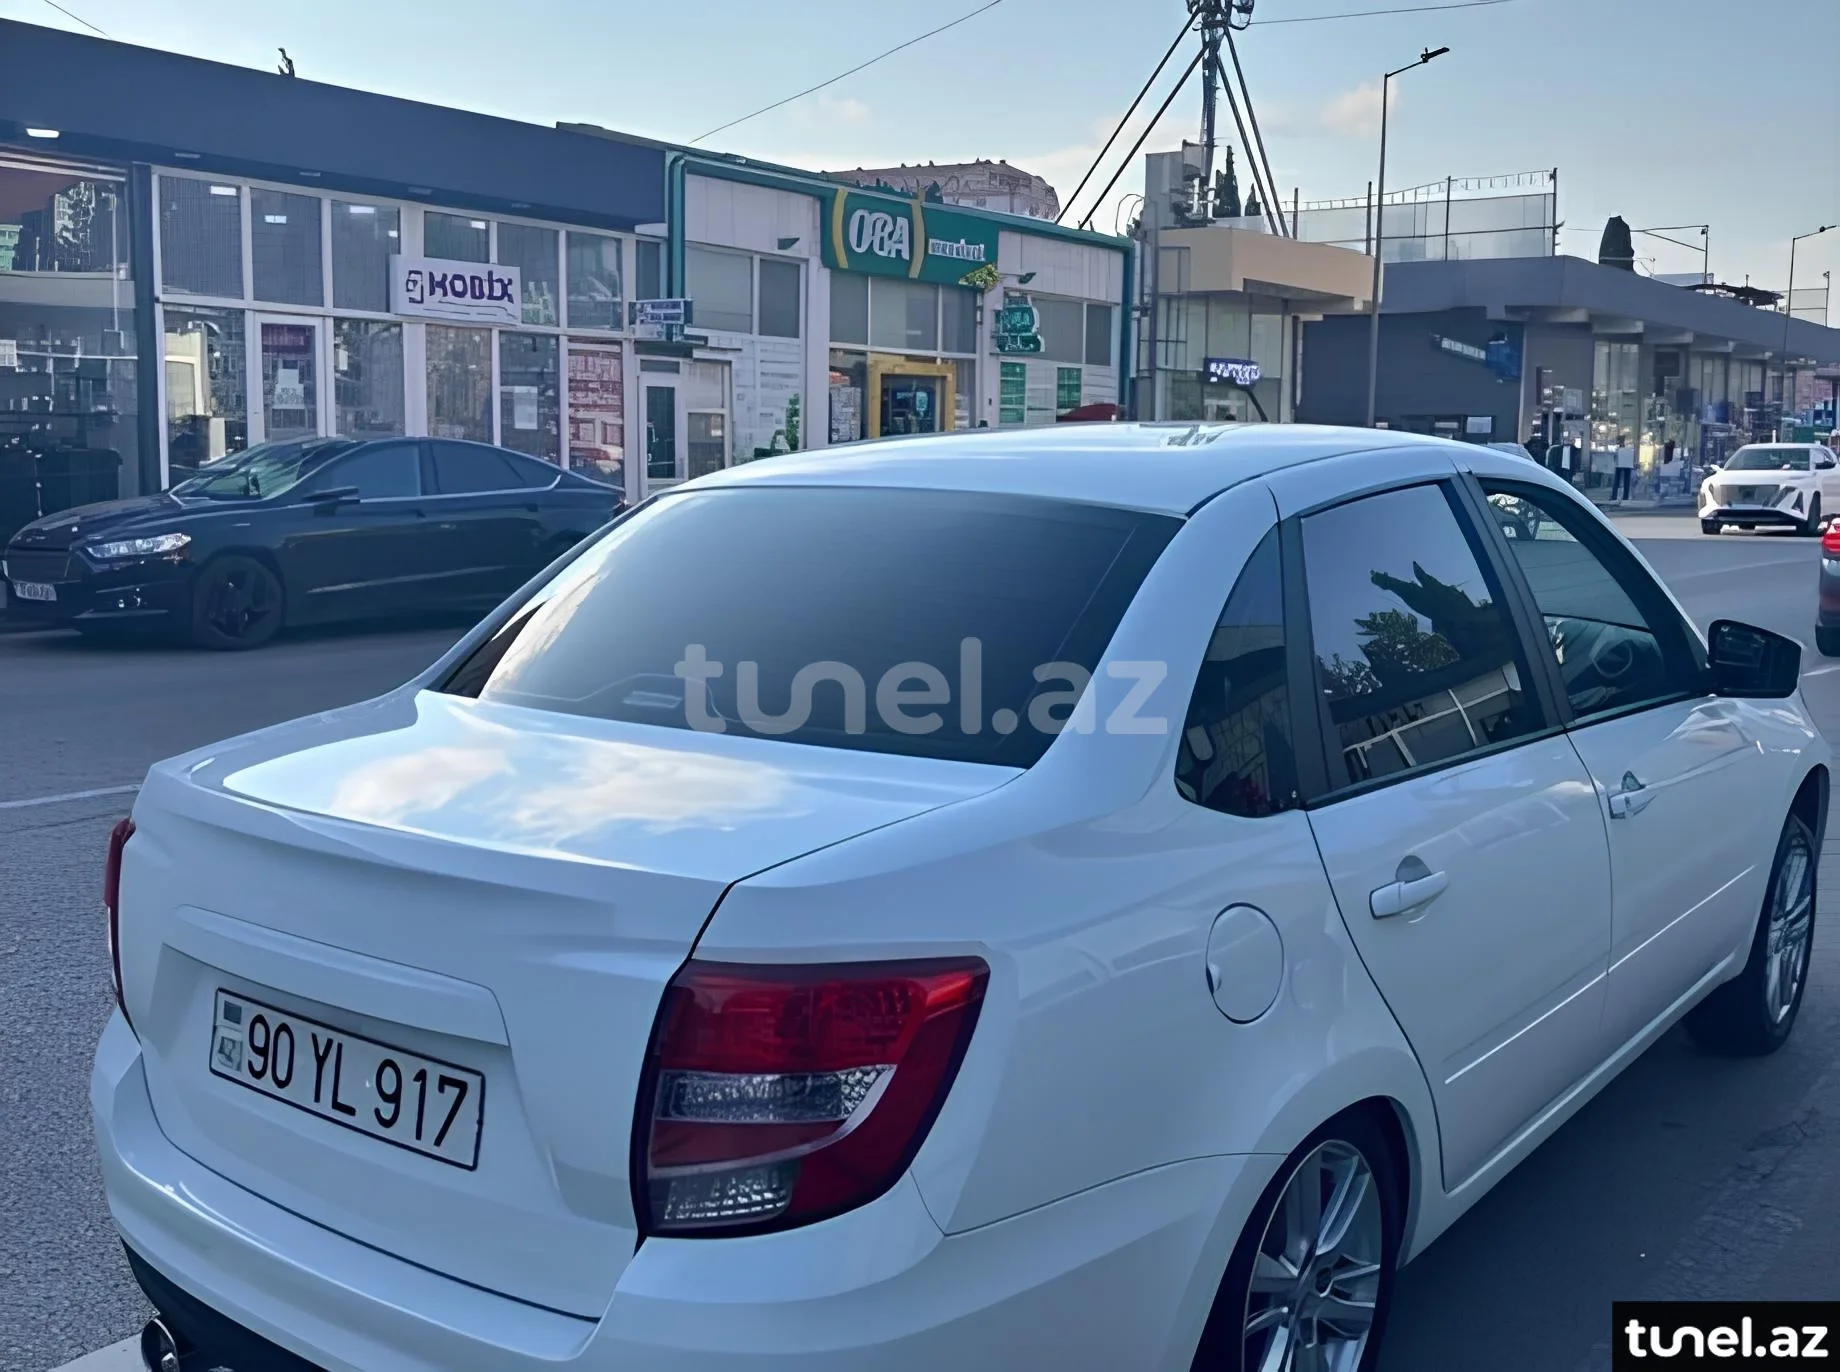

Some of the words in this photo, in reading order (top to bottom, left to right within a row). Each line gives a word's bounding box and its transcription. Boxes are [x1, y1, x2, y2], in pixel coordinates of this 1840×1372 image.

[848, 208, 910, 261] OBA
[247, 1014, 295, 1089] 90
[311, 1032, 356, 1117] YL
[374, 1058, 468, 1147] 917
